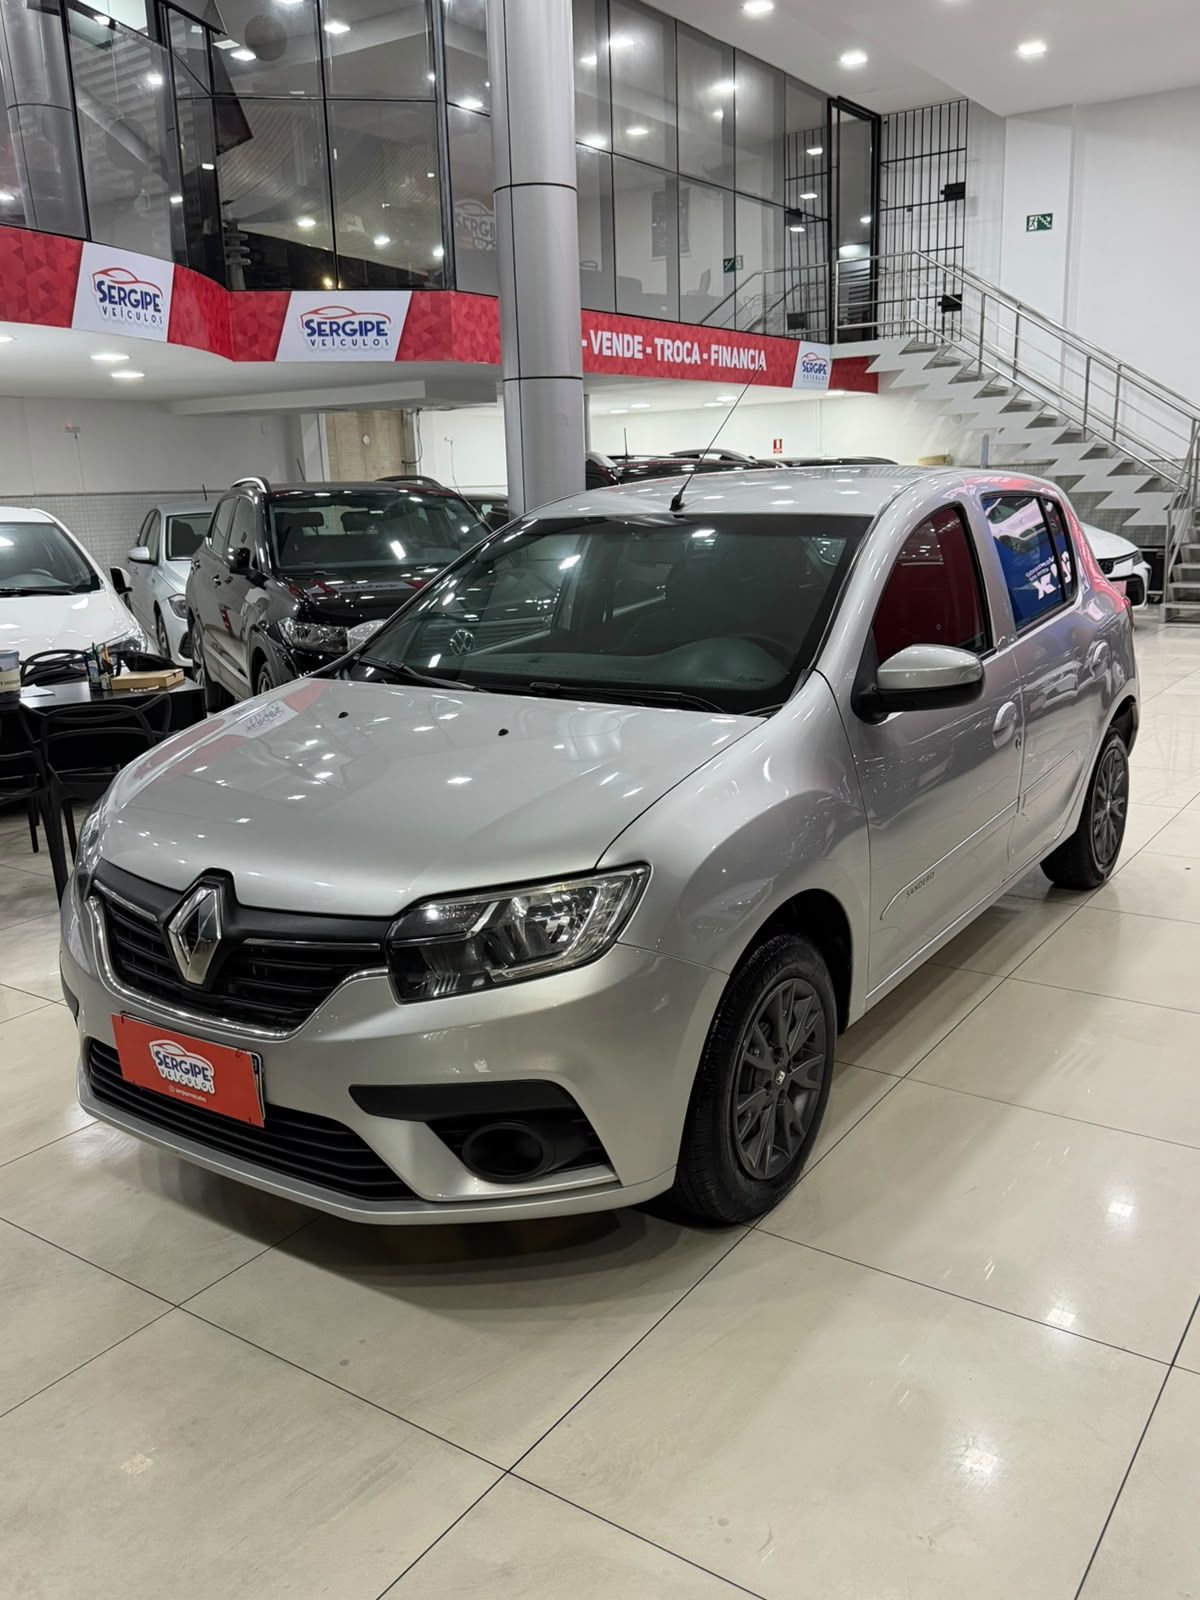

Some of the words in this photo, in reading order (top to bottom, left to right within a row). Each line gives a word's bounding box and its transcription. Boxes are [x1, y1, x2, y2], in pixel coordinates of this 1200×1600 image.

[96, 280, 162, 313] SERGIPE
[304, 318, 389, 337] SERGIPE
[310, 337, 389, 347] VEÍCULOS
[590, 330, 643, 360] VENDE
[654, 337, 701, 365] TROCA
[711, 344, 767, 371] FINANCIA
[906, 871, 935, 898] SANDERO
[155, 1050, 211, 1081] SERGIPE
